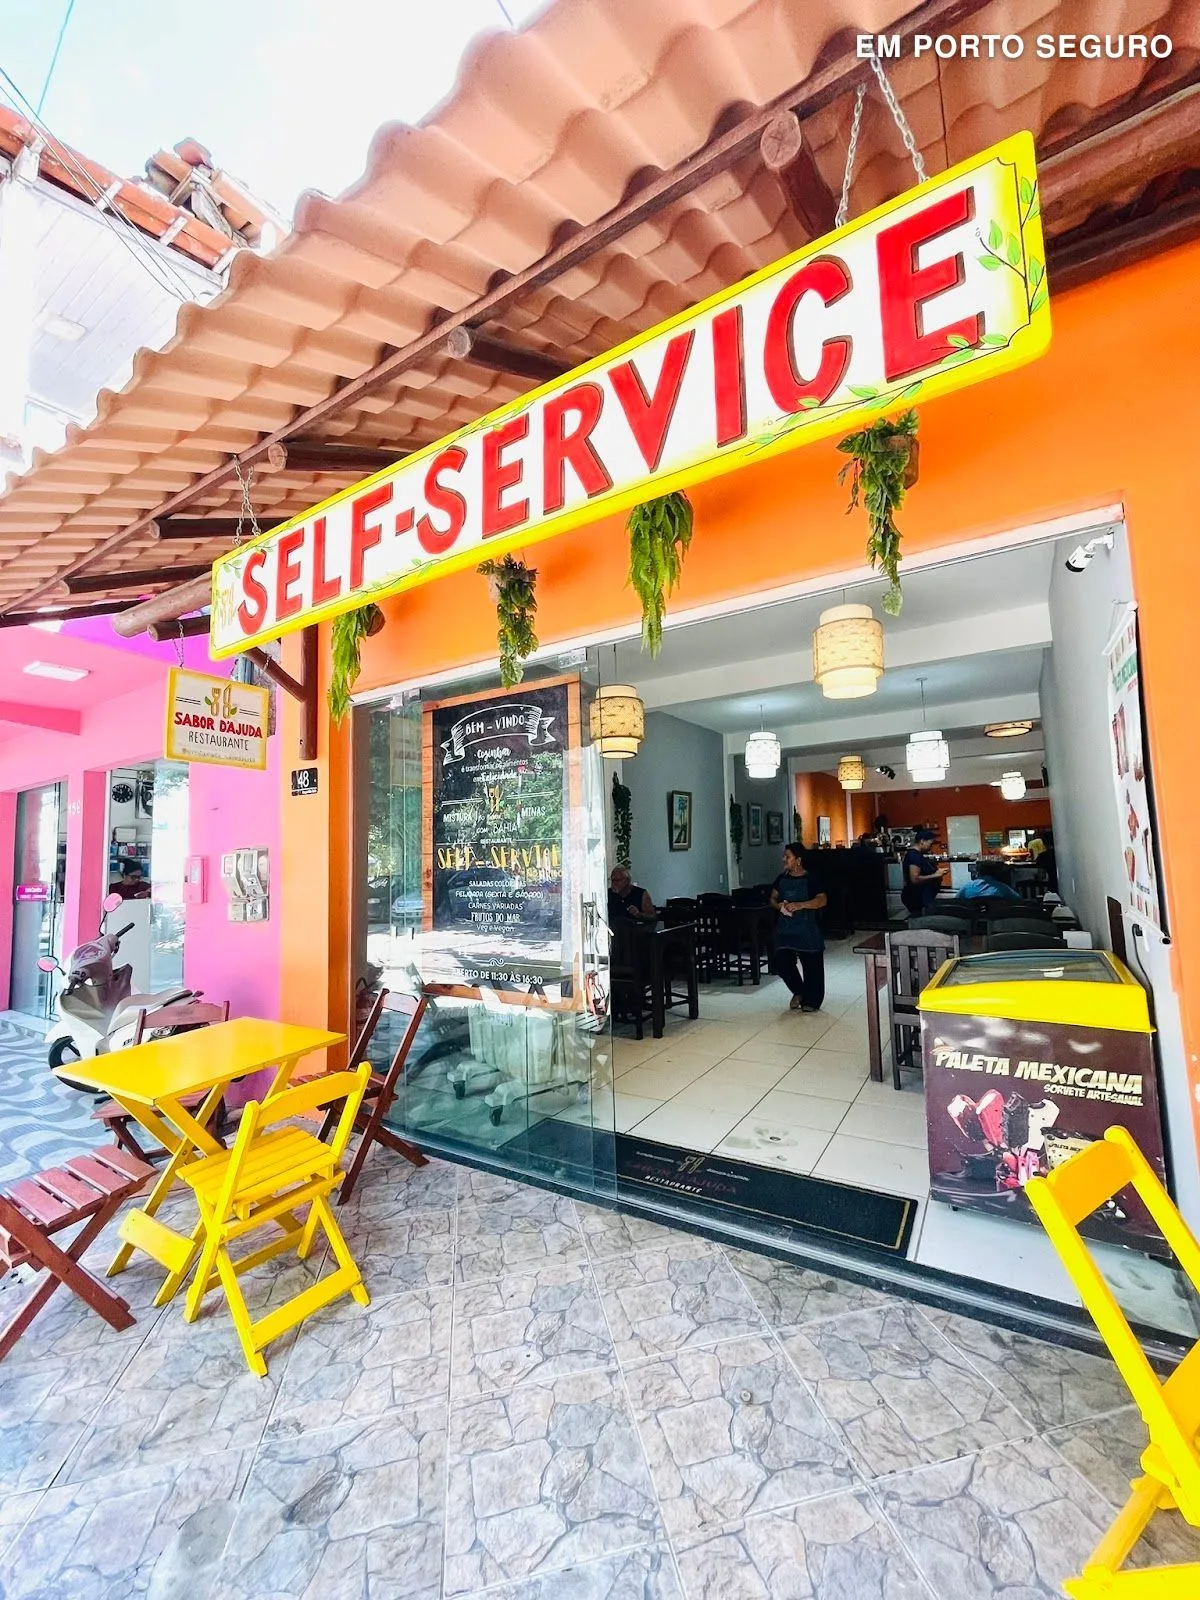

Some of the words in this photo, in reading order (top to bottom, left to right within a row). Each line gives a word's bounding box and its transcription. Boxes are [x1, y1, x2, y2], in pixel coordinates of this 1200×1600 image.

[238, 186, 986, 635] SELF-SERVICE
[174, 711, 215, 731] SABOR
[219, 719, 263, 739] D'AJUDA
[495, 714, 525, 730] VINDO
[188, 730, 249, 751] RESTAURANTE
[521, 806, 546, 818] MINAS
[471, 912, 493, 922] FRUTOS
[496, 913, 504, 922] DO
[491, 972, 508, 981] 11:30
[510, 972, 521, 982] ÀS
[523, 975, 543, 985] 16:30
[935, 1051, 1010, 1076] PALETA
[1014, 1061, 1144, 1095] MEXICANA
[1044, 1083, 1086, 1099] SORVETE
[1087, 1091, 1144, 1107] ARTESANAL
